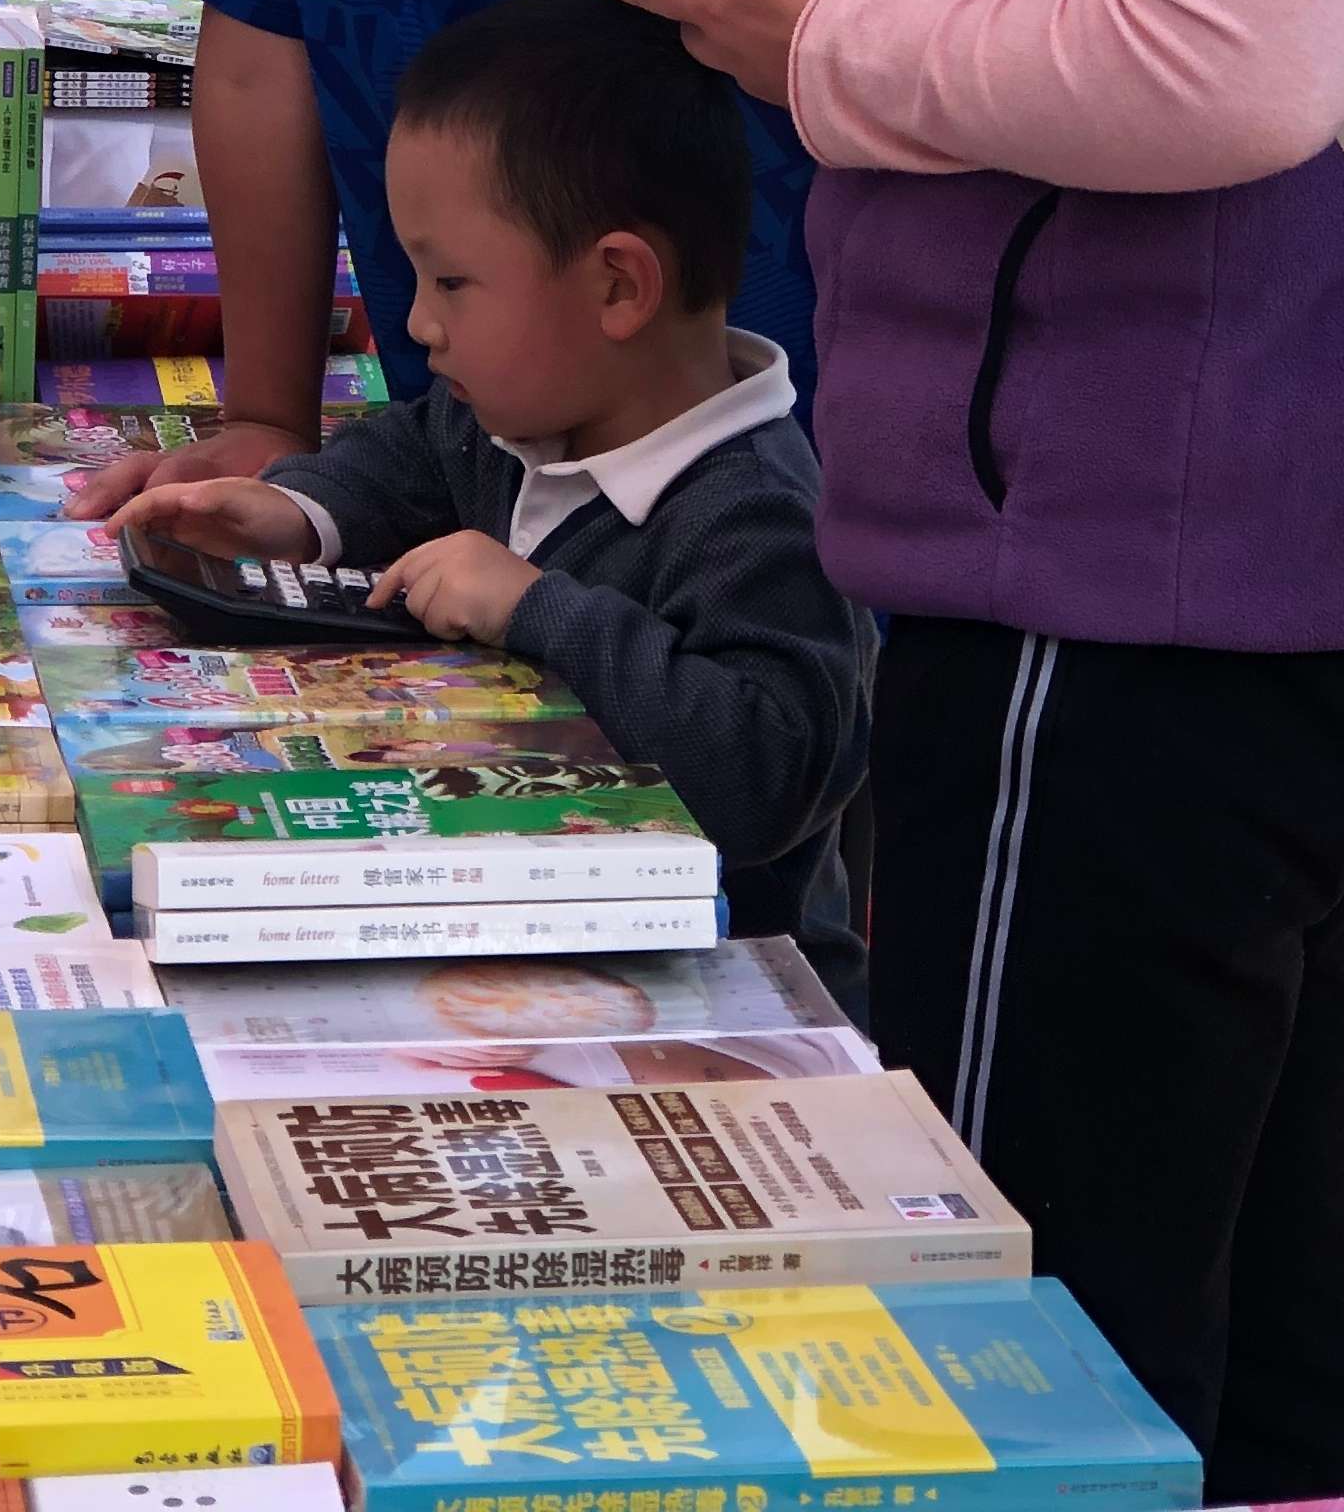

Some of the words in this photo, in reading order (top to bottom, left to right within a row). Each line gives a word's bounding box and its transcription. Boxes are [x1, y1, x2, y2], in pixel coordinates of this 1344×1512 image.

[258, 928, 291, 943] home
[295, 927, 335, 942] letters
[358, 922, 444, 944] 傅雷家书
[262, 872, 295, 886] home
[299, 871, 340, 886] letters
[362, 866, 448, 888] 傅雷家书
[275, 1098, 467, 1244] 大病预防
[417, 1098, 598, 1238] 先除湿热毒
[336, 1245, 686, 1296] 大病预防先除湿热毒
[719, 1252, 773, 1274] 孔繁祥
[782, 1251, 803, 1272] 著
[359, 1303, 582, 1468] 大病预防
[513, 1303, 726, 1463] 先除湿热毒
